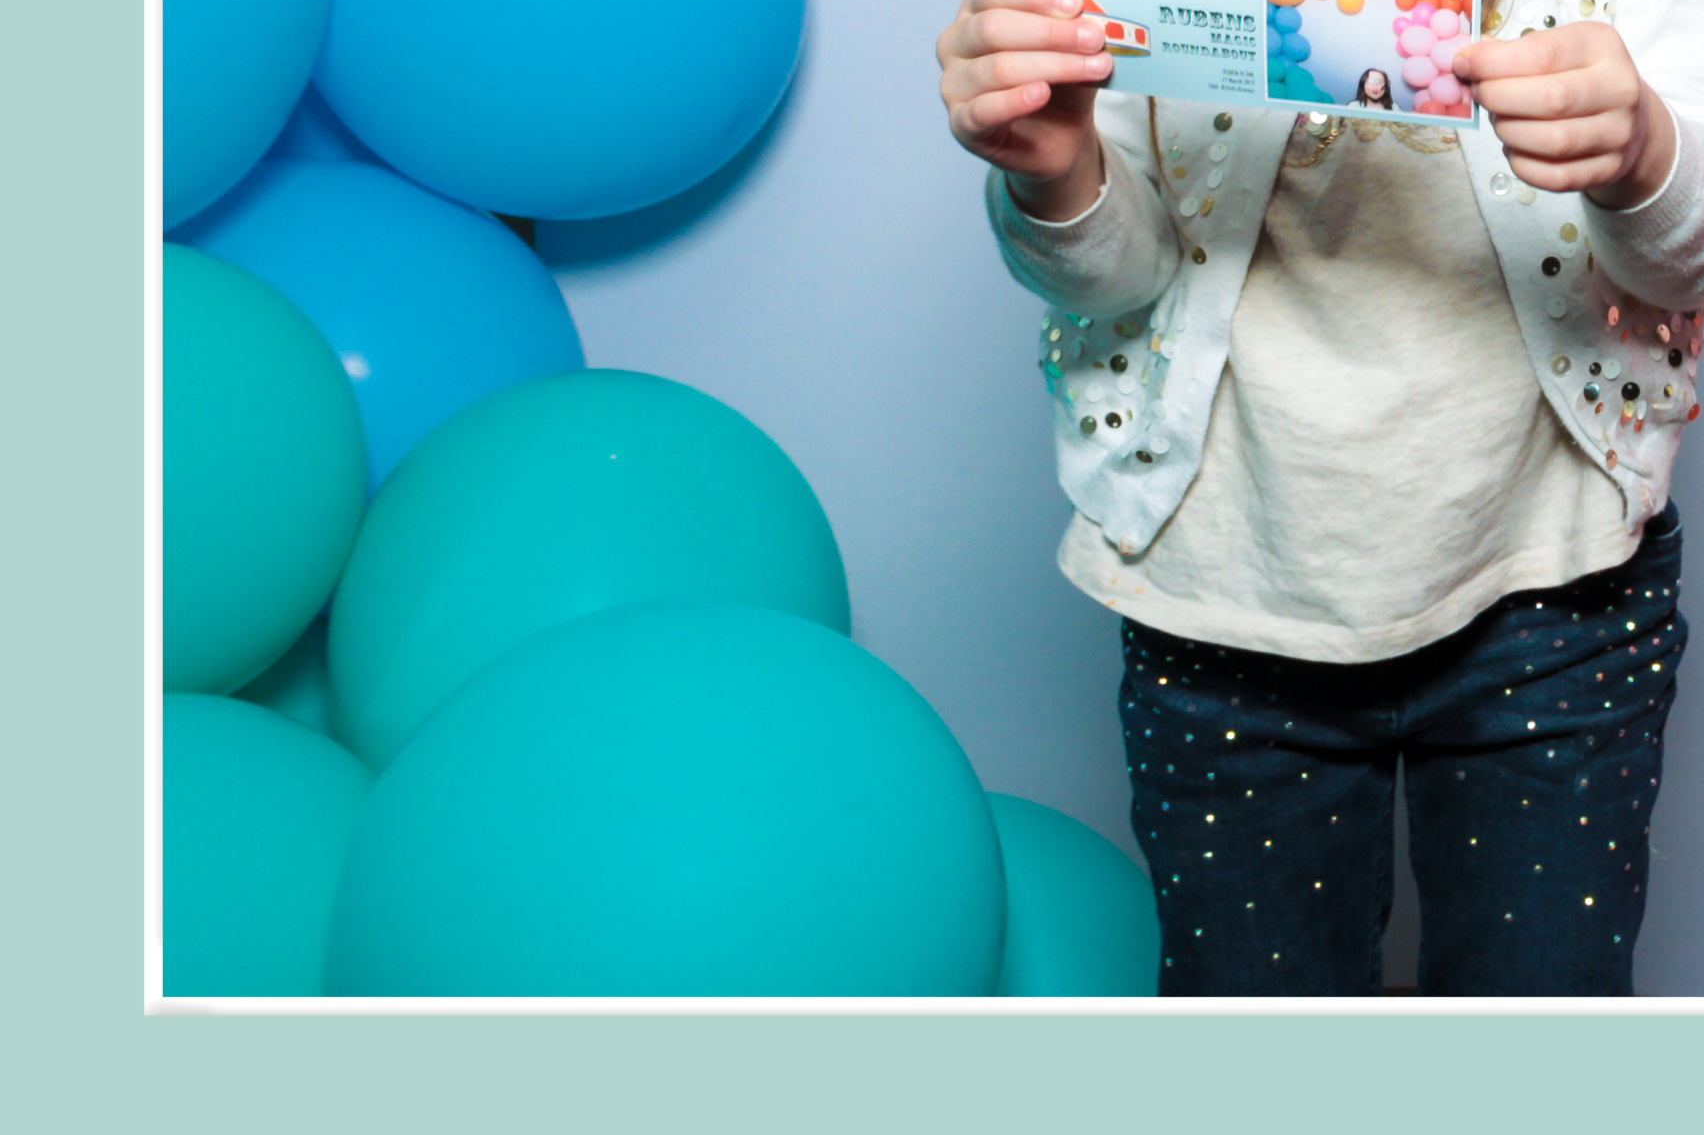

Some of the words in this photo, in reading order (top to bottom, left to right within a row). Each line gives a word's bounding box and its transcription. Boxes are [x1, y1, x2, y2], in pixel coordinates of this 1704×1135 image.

[1158, 5, 1256, 33] RUBENS
[1210, 32, 1256, 47] MAGIC
[1162, 41, 1256, 62] ROUNDABOUT
